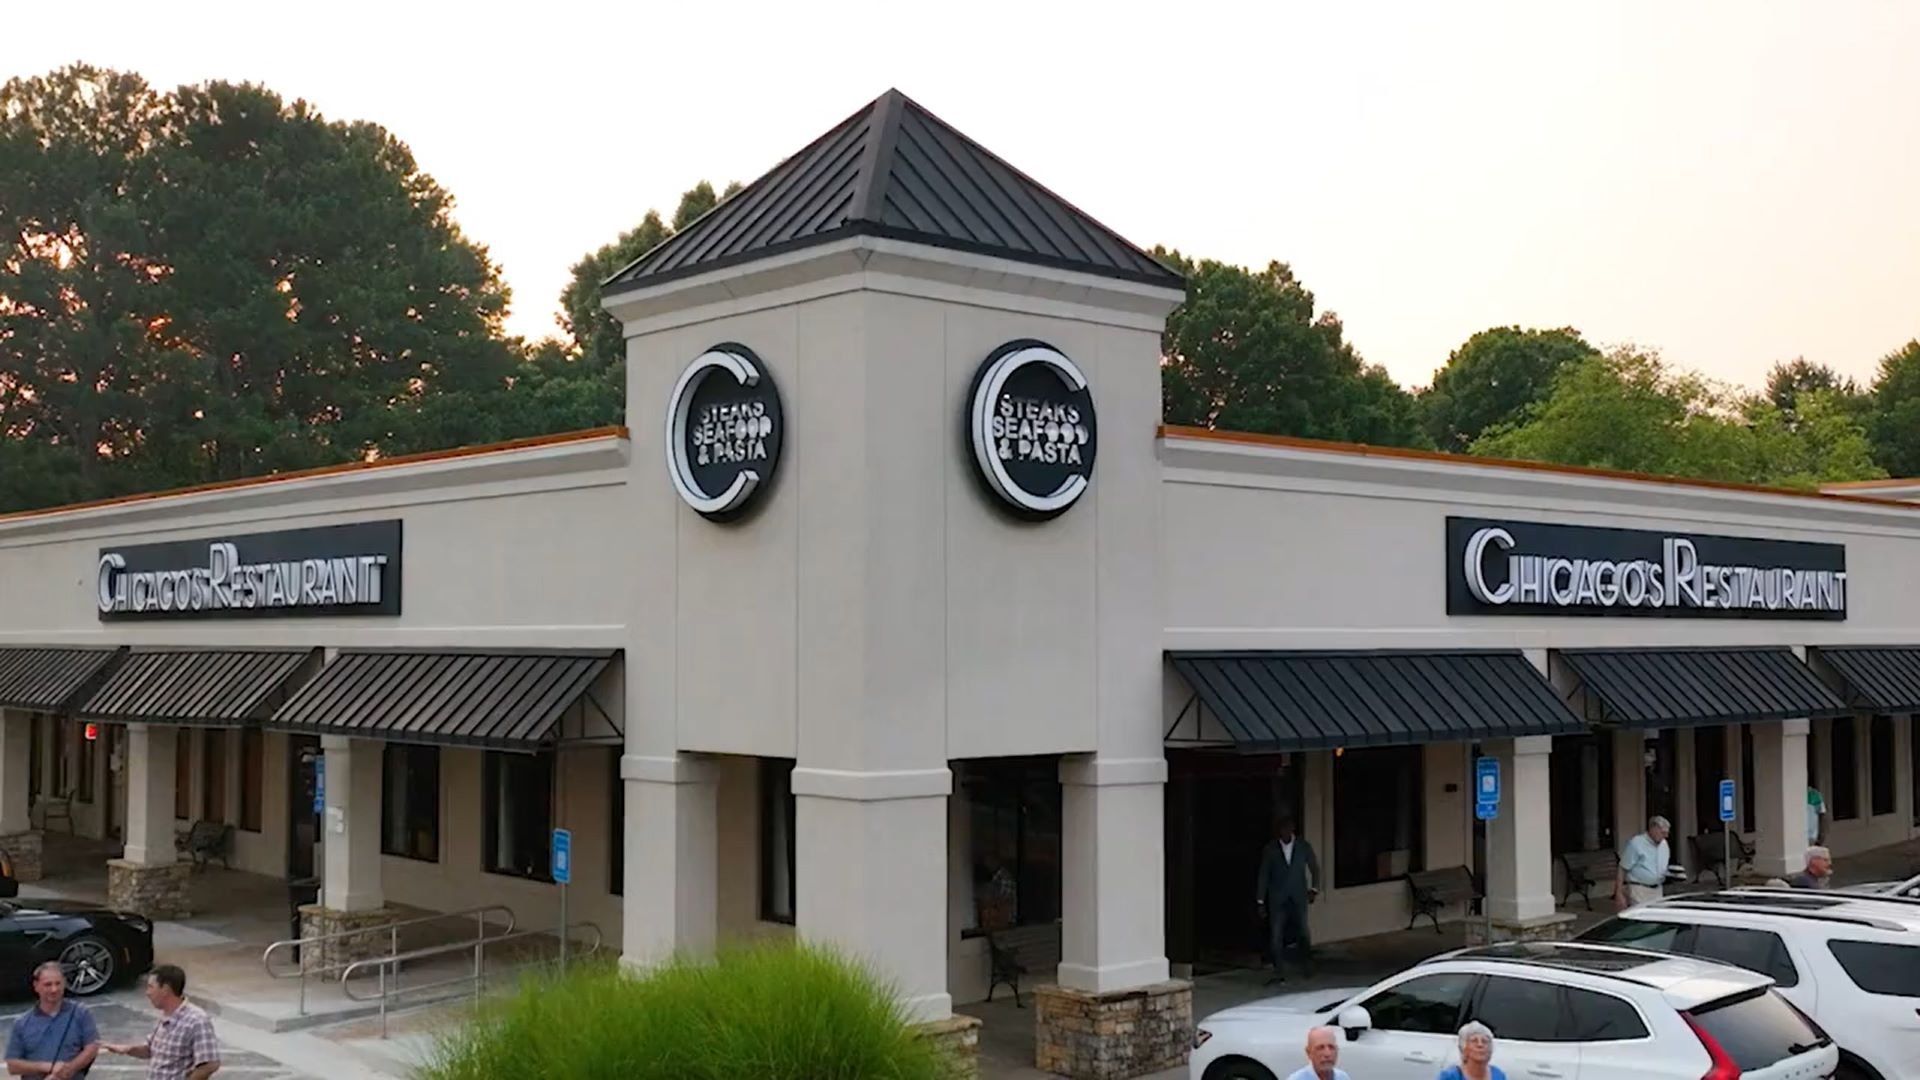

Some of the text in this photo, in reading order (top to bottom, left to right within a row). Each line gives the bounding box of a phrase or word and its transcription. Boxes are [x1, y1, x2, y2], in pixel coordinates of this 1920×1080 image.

[701, 402, 764, 424] STEAKS
[1000, 393, 1080, 424] STEAKS
[693, 416, 772, 446] SEAFOOD
[992, 415, 1089, 445] SEAFOOD
[697, 439, 767, 465] & PASTA
[998, 438, 1082, 465] & PASTA
[209, 542, 388, 608] RESTAURANT
[1664, 537, 1847, 611] RESTAURANT
